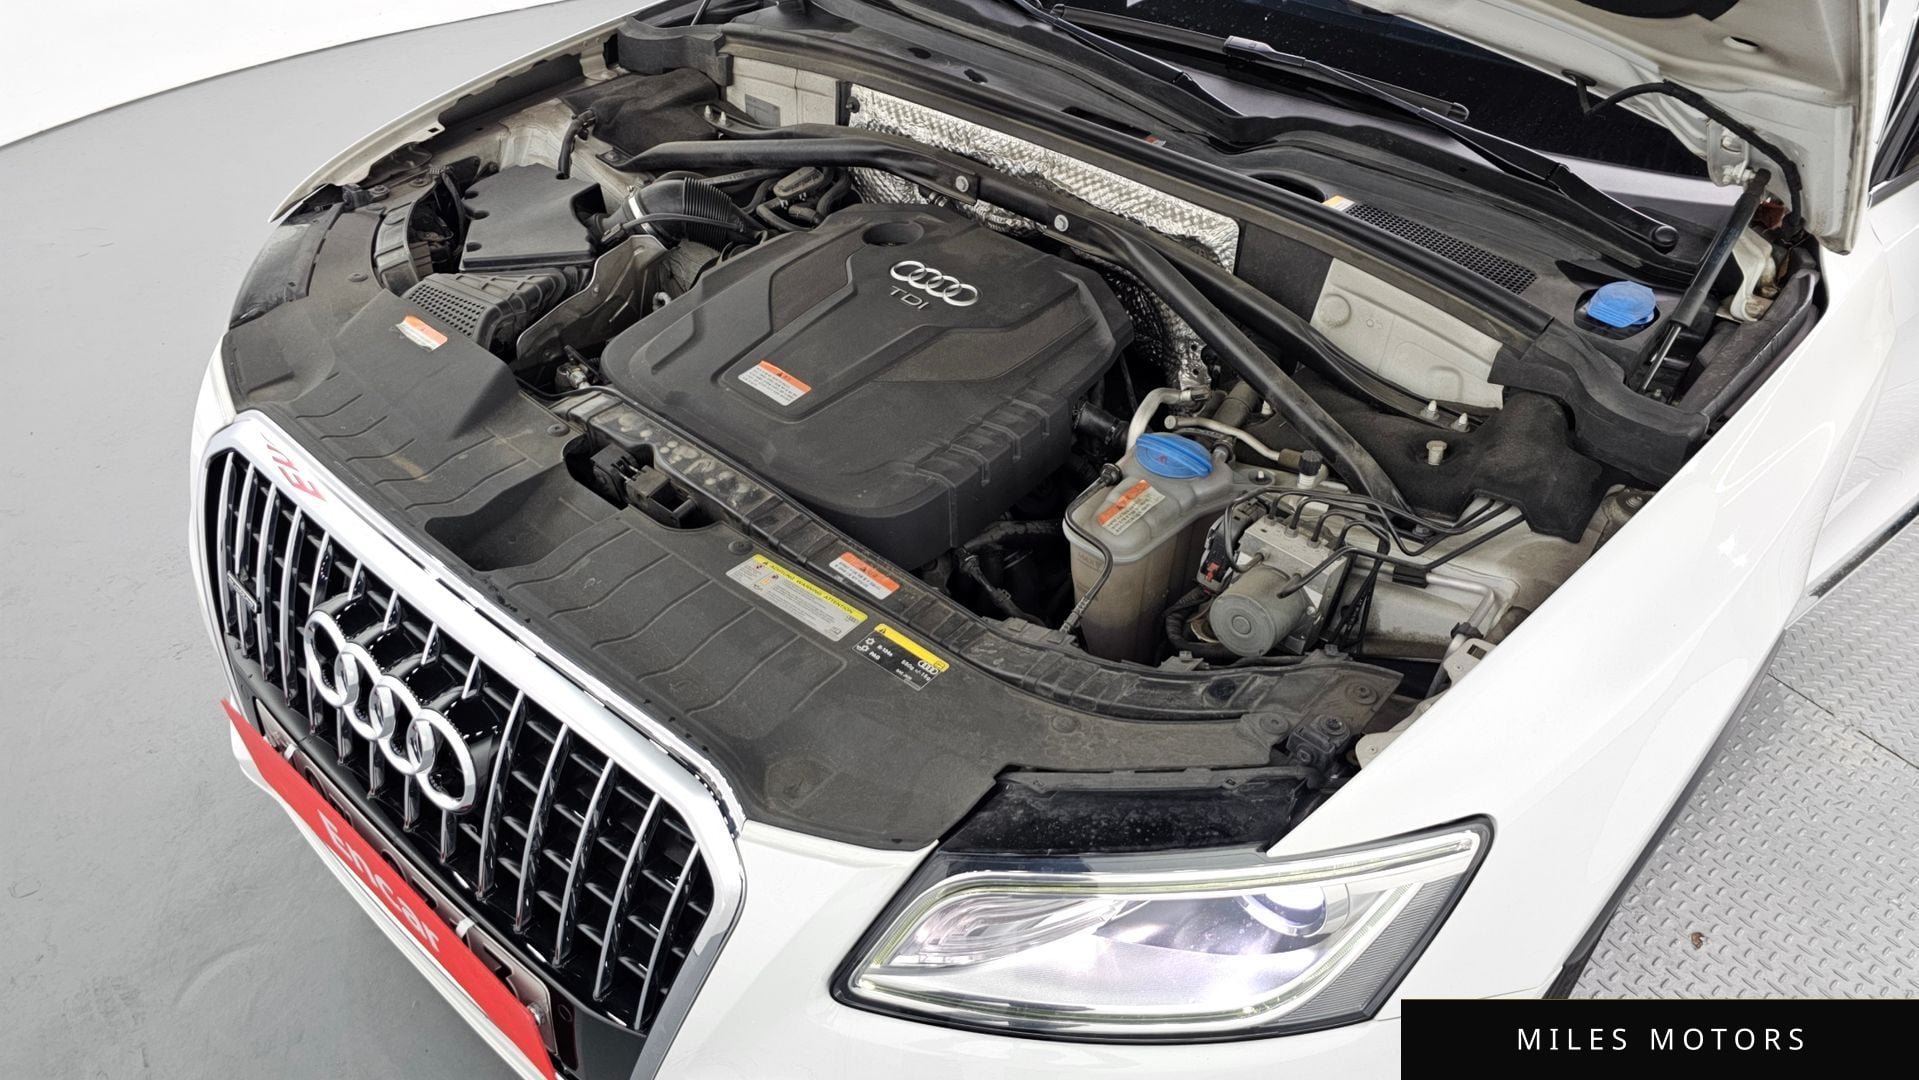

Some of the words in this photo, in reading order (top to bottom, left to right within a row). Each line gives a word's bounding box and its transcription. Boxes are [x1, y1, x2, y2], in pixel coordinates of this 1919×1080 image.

[890, 285, 929, 310] TDI
[796, 578, 823, 595] WARNING
[824, 595, 854, 614] ATTENTION
[316, 809, 440, 952] Encar
